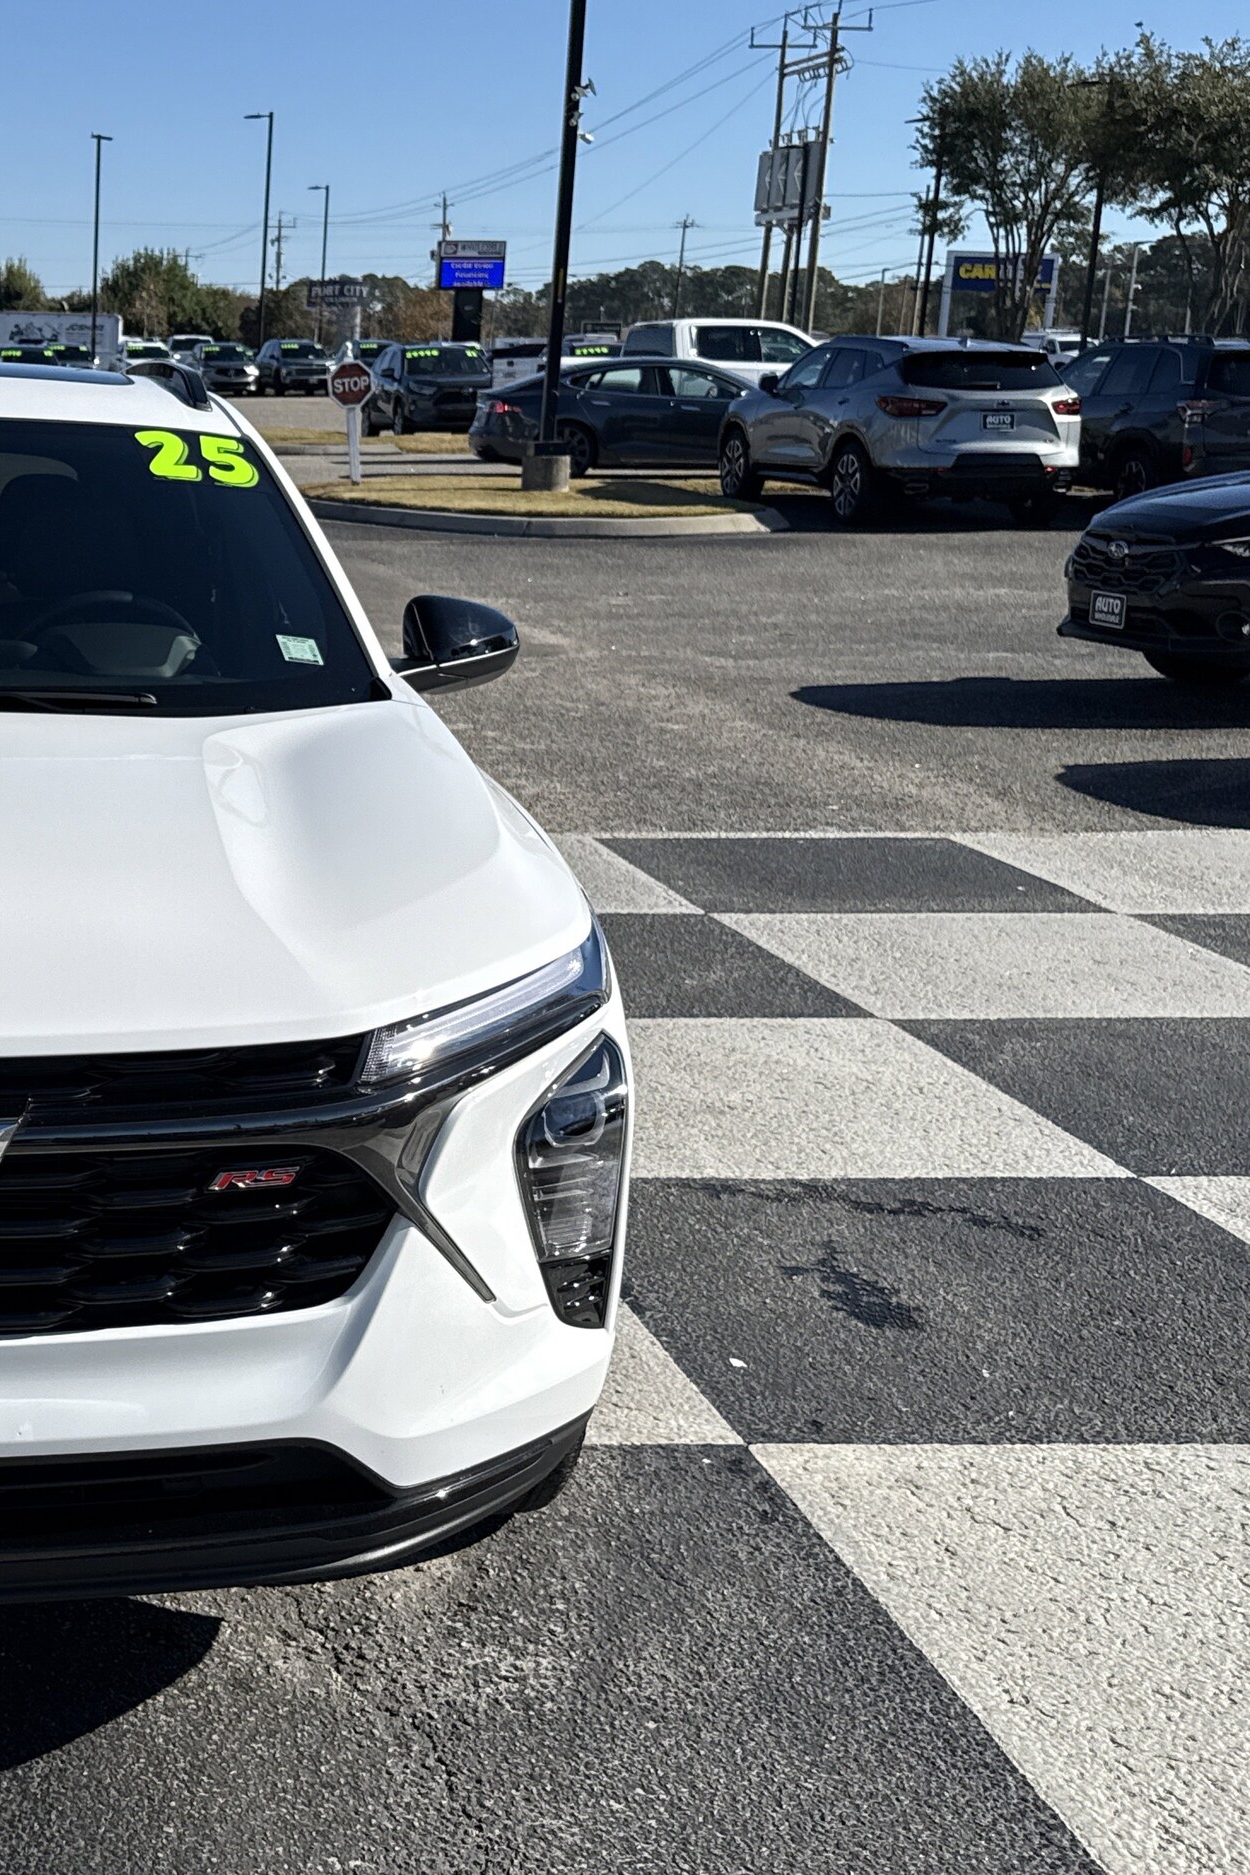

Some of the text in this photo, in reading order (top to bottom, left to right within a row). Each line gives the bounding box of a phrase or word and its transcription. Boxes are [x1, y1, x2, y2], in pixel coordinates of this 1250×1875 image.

[343, 285, 369, 298] CITY
[333, 376, 370, 394] STOP
[986, 415, 1011, 424] AUTO
[134, 430, 260, 488] 25
[1095, 595, 1121, 614] AUTO
[207, 1166, 301, 1192] RS
